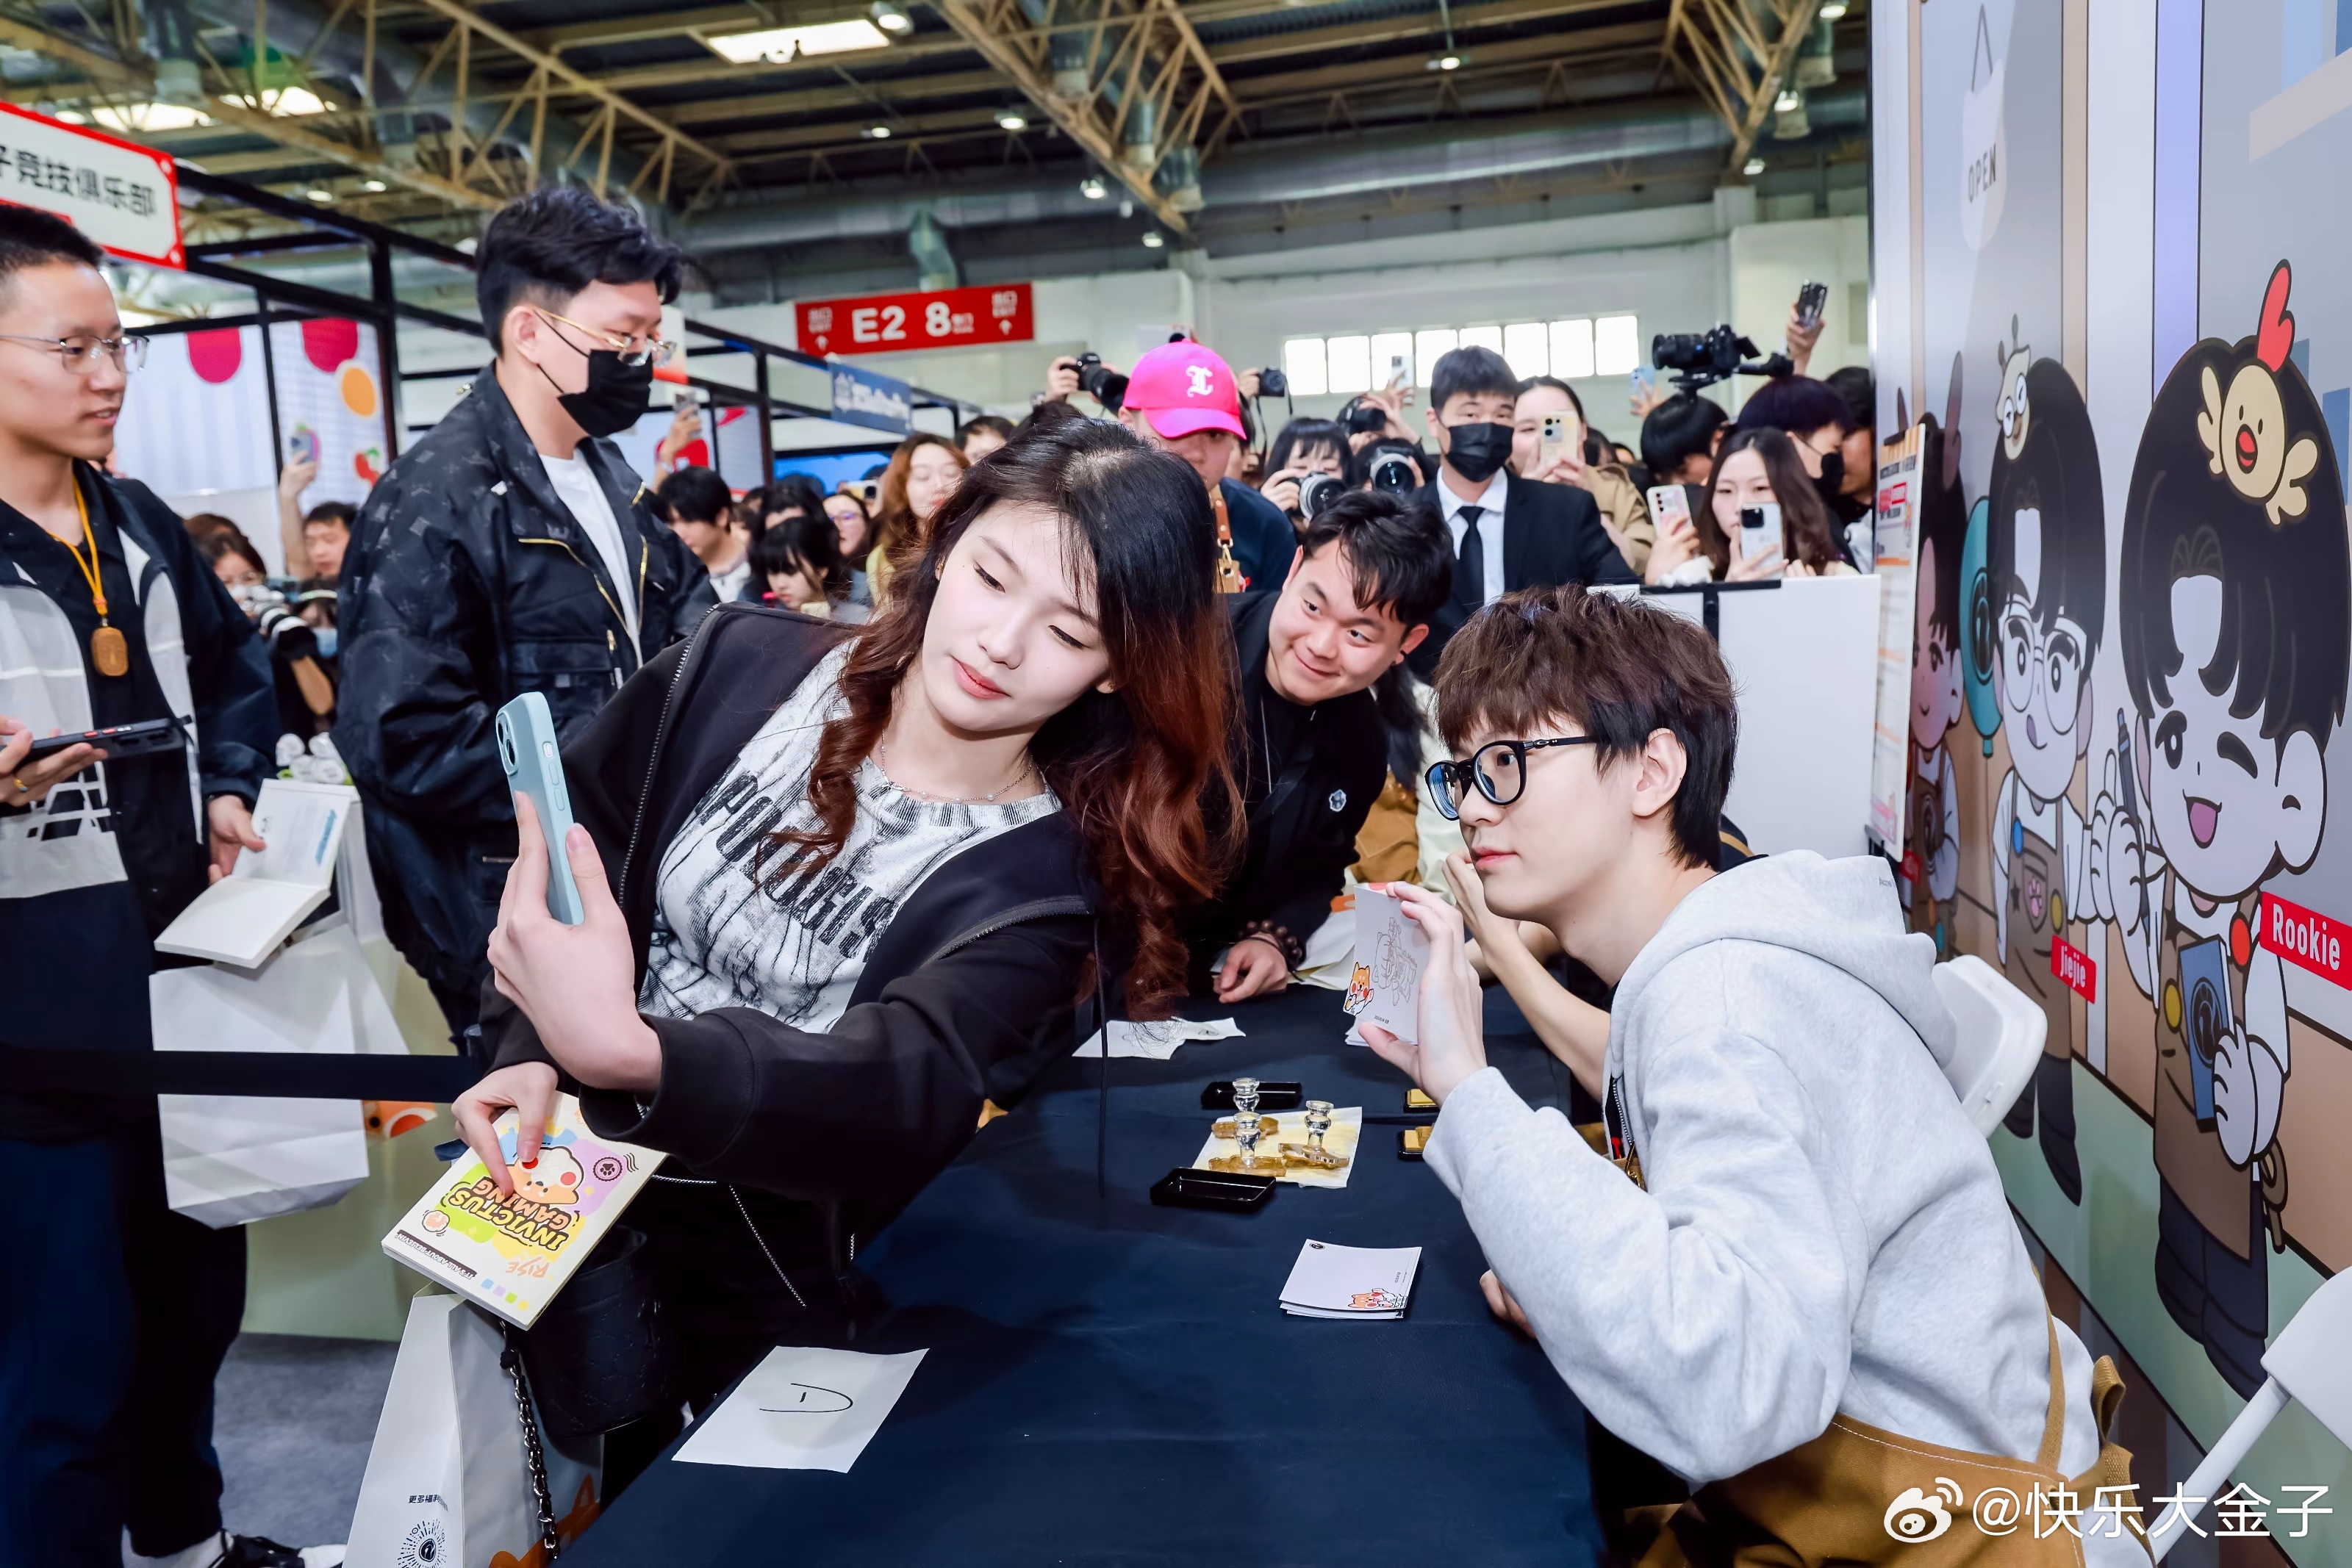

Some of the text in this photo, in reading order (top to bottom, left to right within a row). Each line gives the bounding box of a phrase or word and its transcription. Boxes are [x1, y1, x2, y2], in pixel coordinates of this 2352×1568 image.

[1968, 143, 1996, 204] OPEN
[852, 305, 906, 343] E2
[925, 301, 951, 337] 8
[2273, 903, 2340, 971] Rookie
[449, 1189, 567, 1250] INVICTUS
[473, 1179, 570, 1230] GAMING
[426, 1249, 448, 1265] ABOUT
[506, 1256, 550, 1279] RISE
